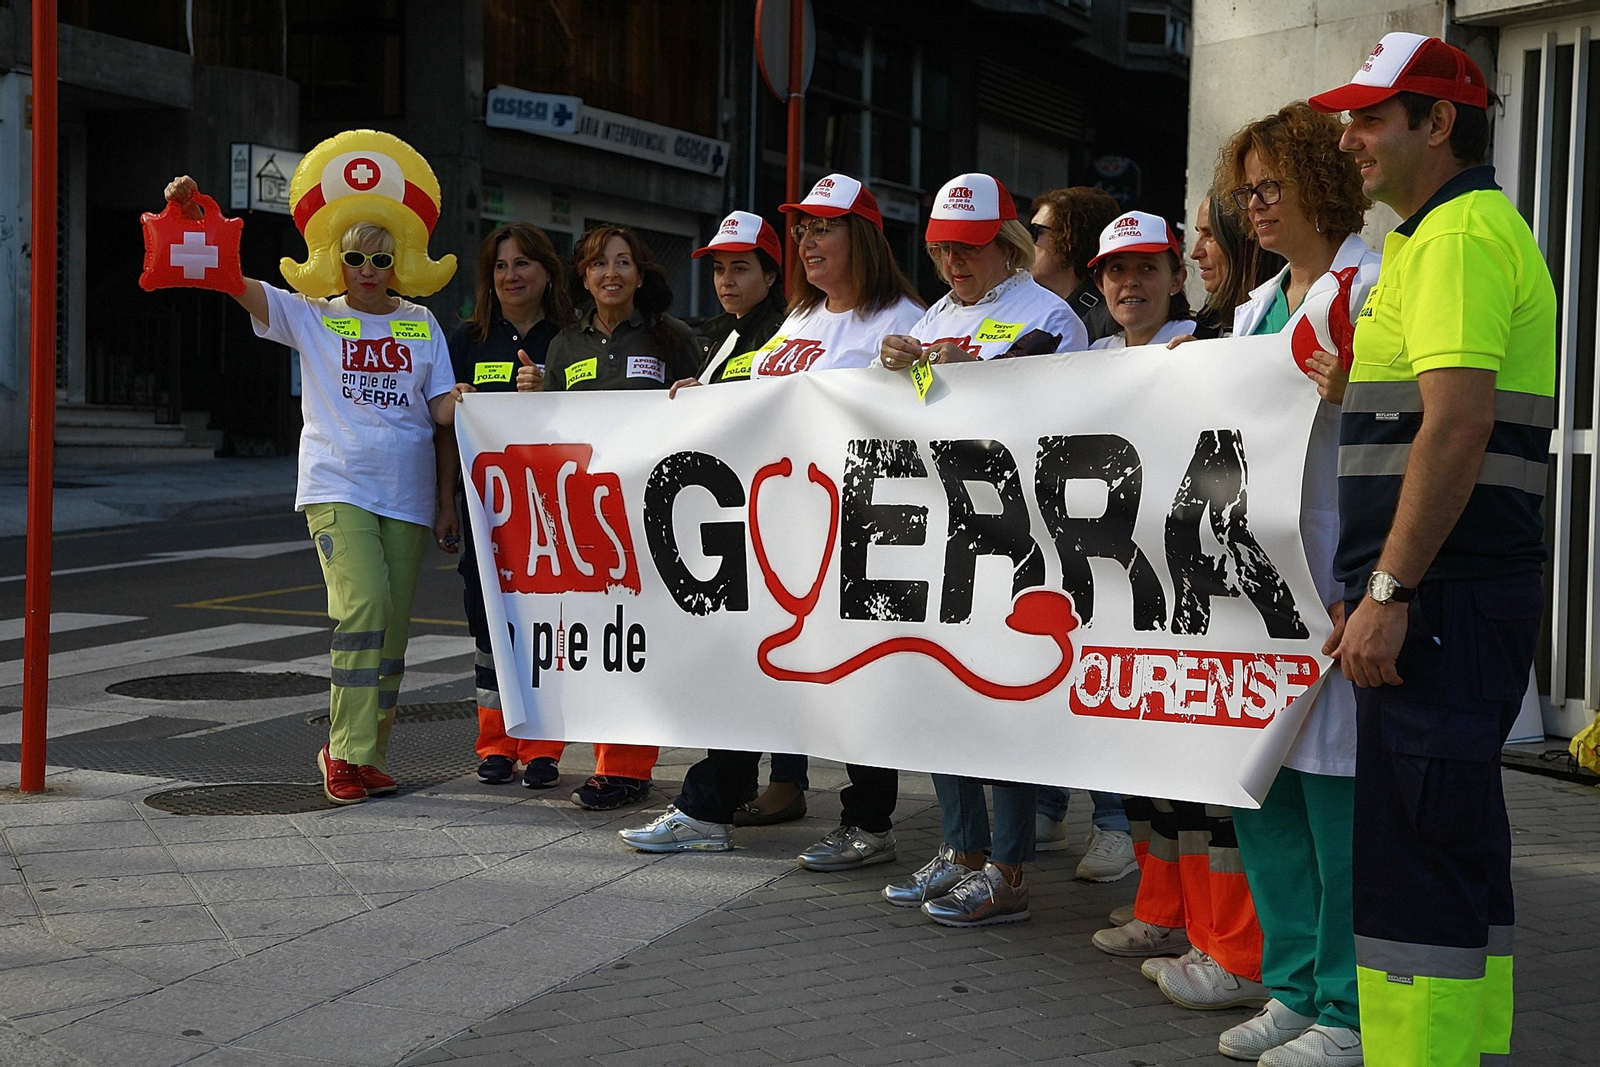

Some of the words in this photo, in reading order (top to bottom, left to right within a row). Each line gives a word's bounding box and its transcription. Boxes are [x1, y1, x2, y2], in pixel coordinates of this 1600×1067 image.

[493, 97, 547, 119] asisa
[674, 134, 711, 165] asisa
[326, 323, 357, 336] FOLGA
[477, 373, 506, 381] FOLGA
[633, 363, 661, 372] FOLGA
[341, 372, 356, 384] en
[360, 374, 378, 389] pie
[382, 374, 397, 389] de
[568, 371, 593, 386] FOLGA
[342, 386, 410, 407] GUERRA
[643, 429, 1310, 639] GUERRA
[532, 602, 588, 688] pie
[603, 604, 647, 672] de
[1075, 652, 1310, 720] OURENSE
